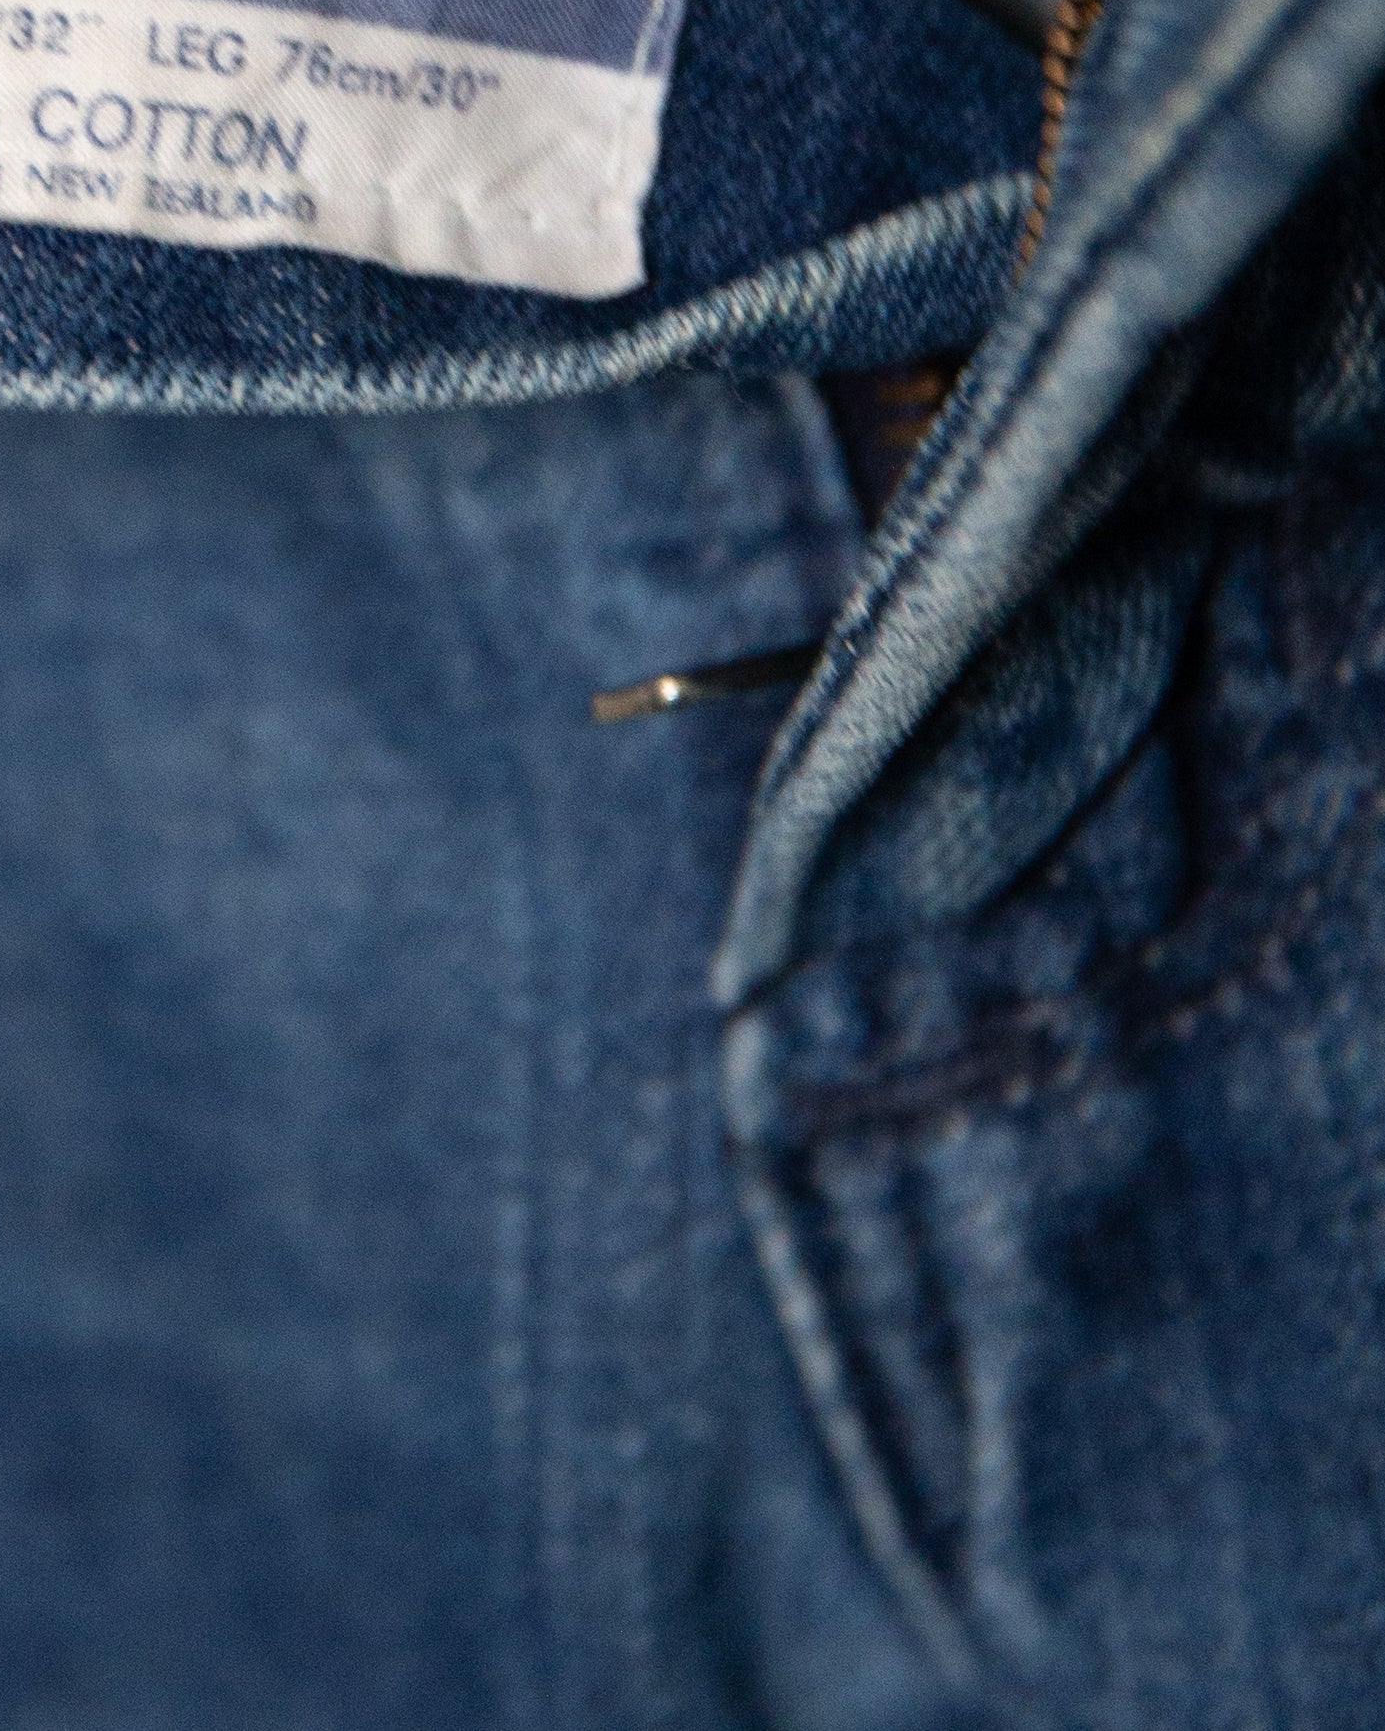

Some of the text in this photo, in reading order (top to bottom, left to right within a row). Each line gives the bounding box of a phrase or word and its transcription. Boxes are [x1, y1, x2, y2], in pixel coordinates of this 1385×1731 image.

[147, 19, 247, 76] LEG
[30, 87, 308, 169] COTTON
[27, 163, 122, 200] NEW
[144, 174, 316, 223] ZEALAND
